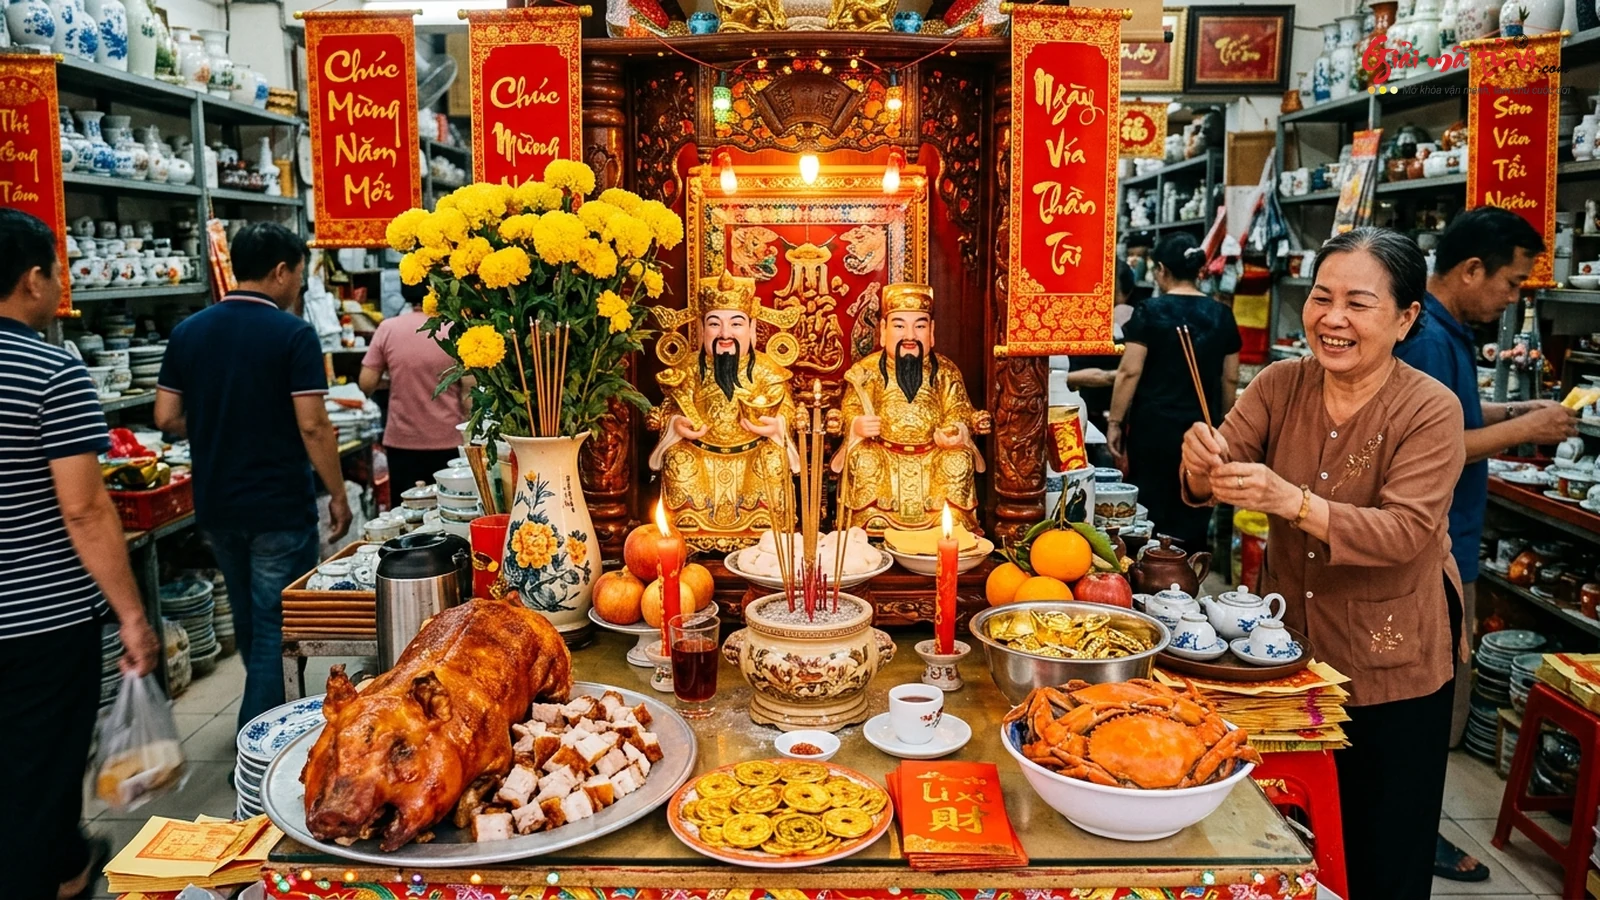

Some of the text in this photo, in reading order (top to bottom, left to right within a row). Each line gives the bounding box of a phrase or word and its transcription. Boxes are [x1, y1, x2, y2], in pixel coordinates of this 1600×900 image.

[324, 49, 400, 83] Chúc
[490, 76, 560, 108] Chúc
[1034, 68, 1105, 125] Ngày
[335, 132, 397, 168] Năm
[1046, 128, 1087, 168] Vía
[344, 172, 395, 209] Mới
[1033, 181, 1096, 224] Thần
[1046, 232, 1083, 275] Tài
